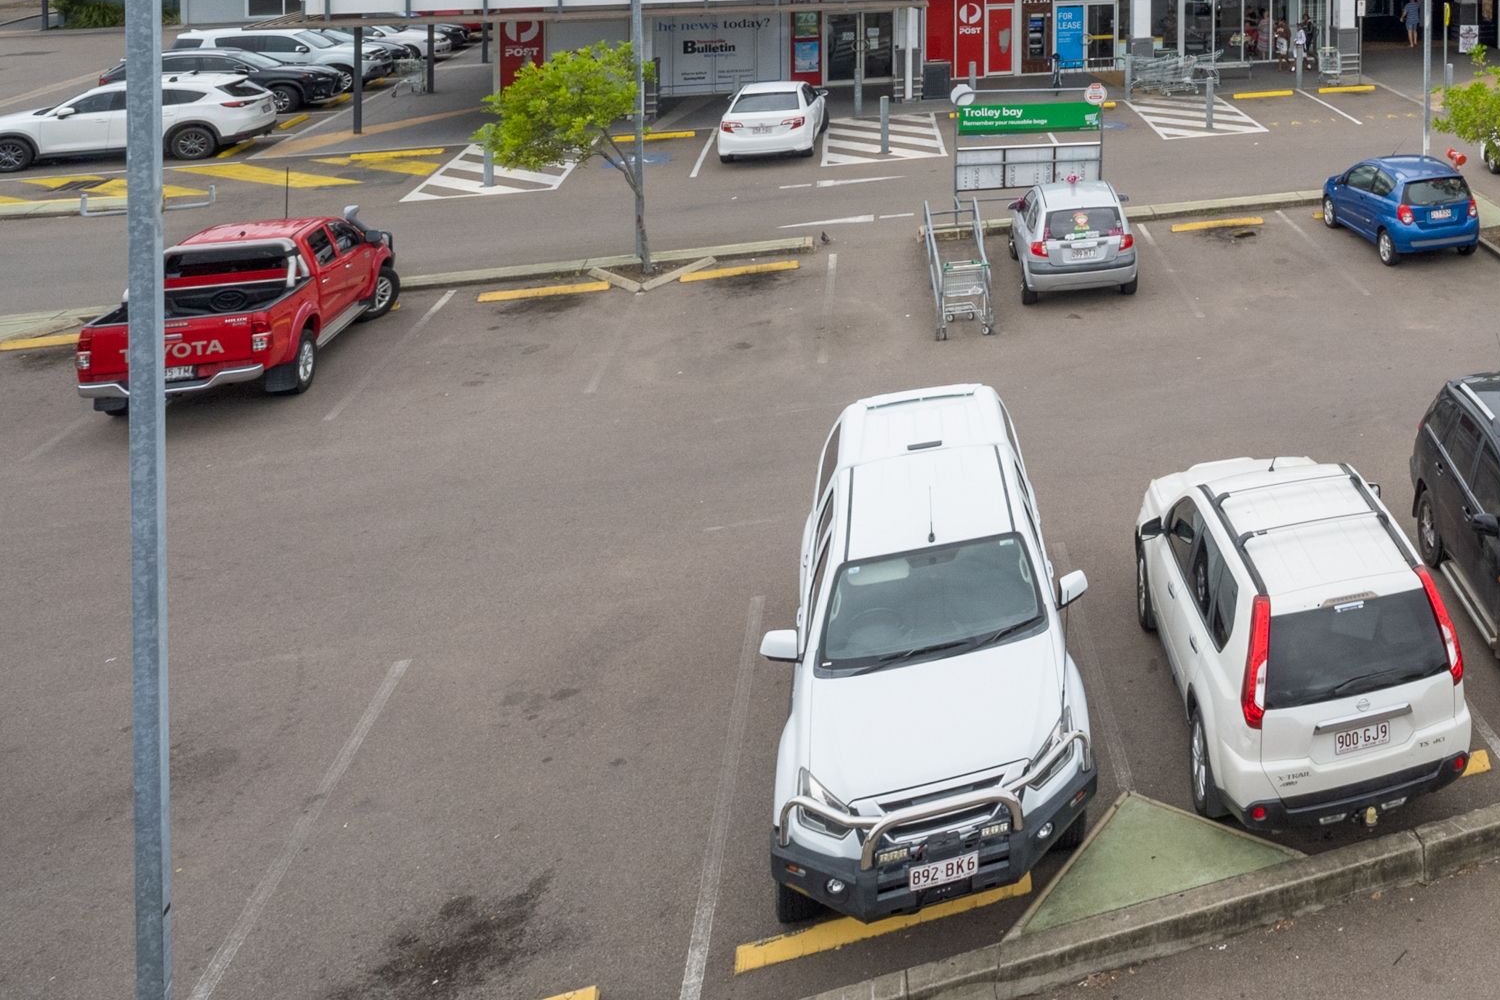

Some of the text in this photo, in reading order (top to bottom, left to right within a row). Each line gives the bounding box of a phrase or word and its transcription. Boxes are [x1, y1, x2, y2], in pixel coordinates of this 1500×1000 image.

[1058, 12, 1073, 20] FOR
[681, 21, 719, 31] news
[724, 18, 770, 30] today?
[1058, 21, 1081, 29] LEASE
[960, 27, 981, 35] POST
[505, 47, 539, 57] POST
[683, 40, 736, 55] Bulletin
[963, 107, 1023, 118] Trolley bay
